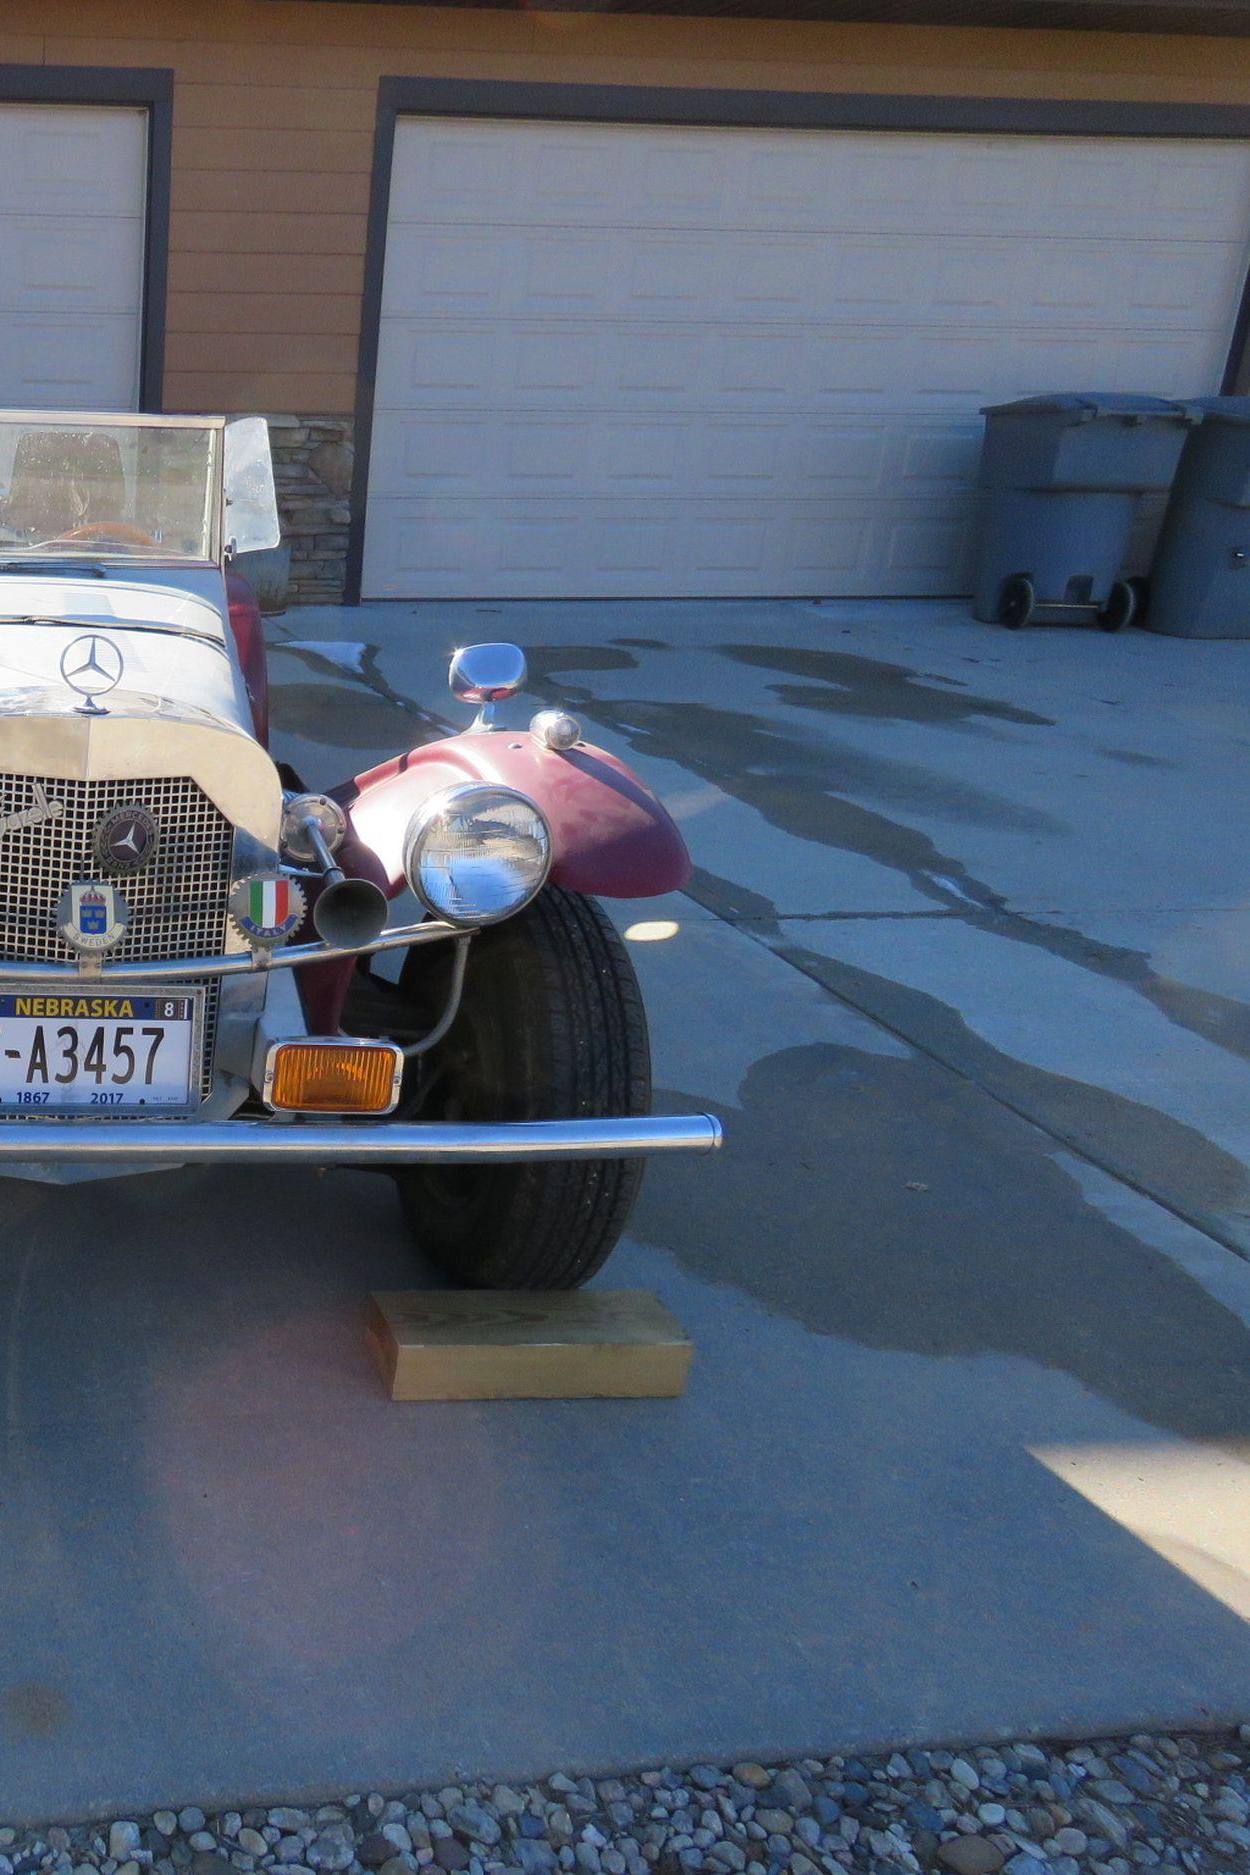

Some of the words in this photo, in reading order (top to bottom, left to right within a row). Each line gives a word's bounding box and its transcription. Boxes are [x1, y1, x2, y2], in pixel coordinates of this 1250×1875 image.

[15, 997, 134, 1018] NEBRASKA
[164, 1001, 174, 1018] 8
[16, 1091, 50, 1104] 1867
[90, 1092, 124, 1105] 2017
